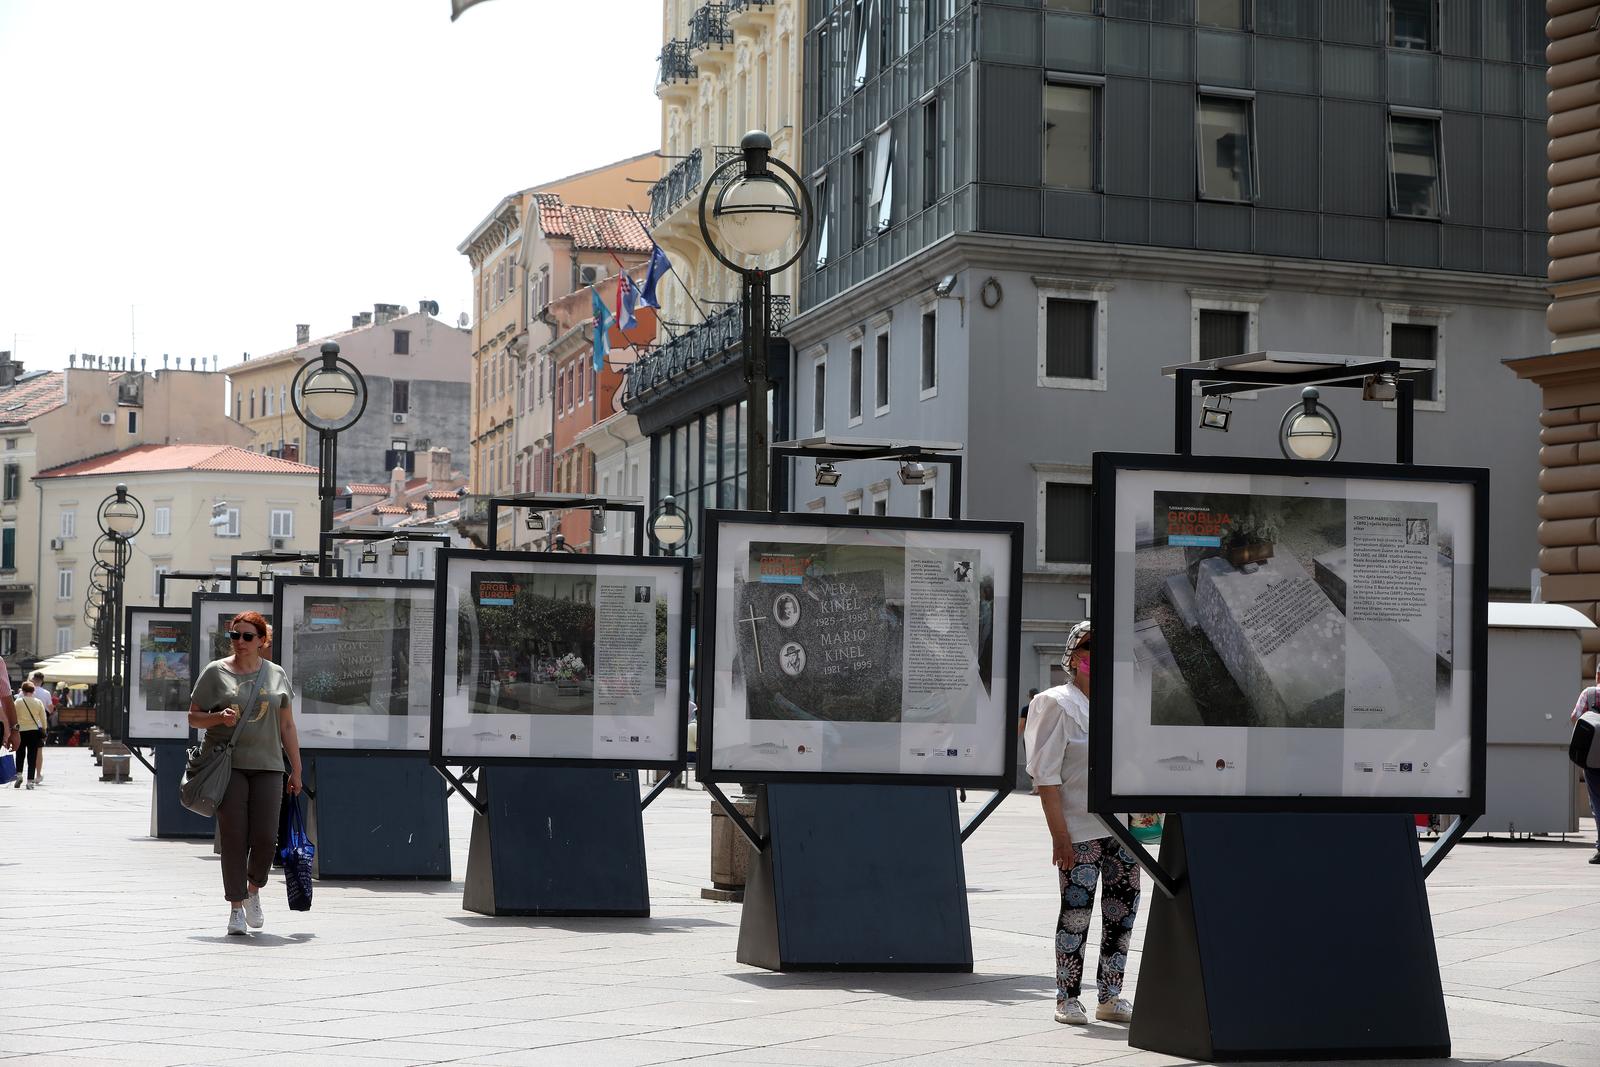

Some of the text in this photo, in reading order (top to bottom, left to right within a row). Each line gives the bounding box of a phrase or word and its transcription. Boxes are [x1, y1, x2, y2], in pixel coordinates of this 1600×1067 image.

[1168, 511, 1231, 524] GROBLJA
[1168, 523, 1220, 535] EUROPE
[480, 584, 521, 592] GROBLJA
[820, 582, 858, 596] VERA
[820, 598, 860, 613] KINEL
[821, 628, 866, 646] MARIO
[824, 646, 865, 662] KINEL
[853, 660, 872, 670] 1995
